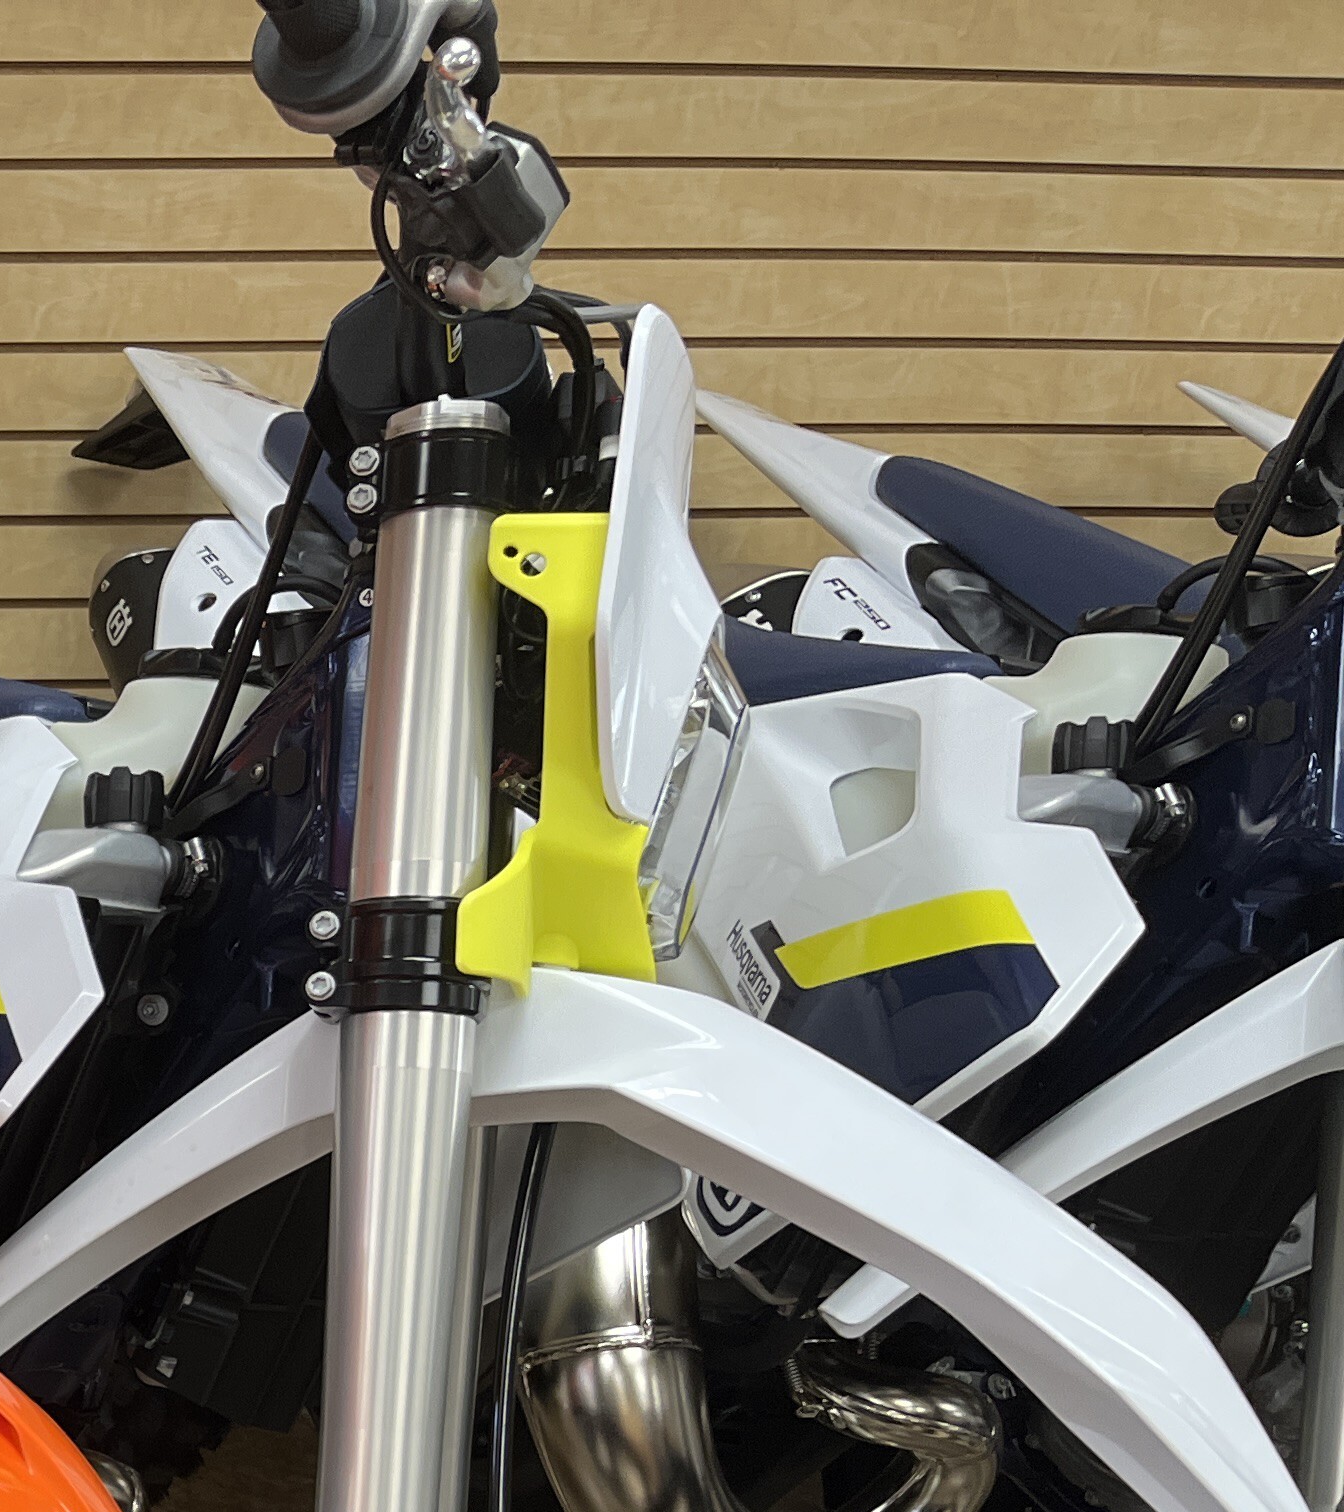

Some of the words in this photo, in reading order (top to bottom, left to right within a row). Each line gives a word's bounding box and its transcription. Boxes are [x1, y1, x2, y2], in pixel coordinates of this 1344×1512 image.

[195, 545, 220, 567] TE
[211, 565, 235, 587] 150
[823, 577, 858, 602] FC
[854, 599, 892, 631] 250
[726, 919, 772, 1006] Husqvarna
